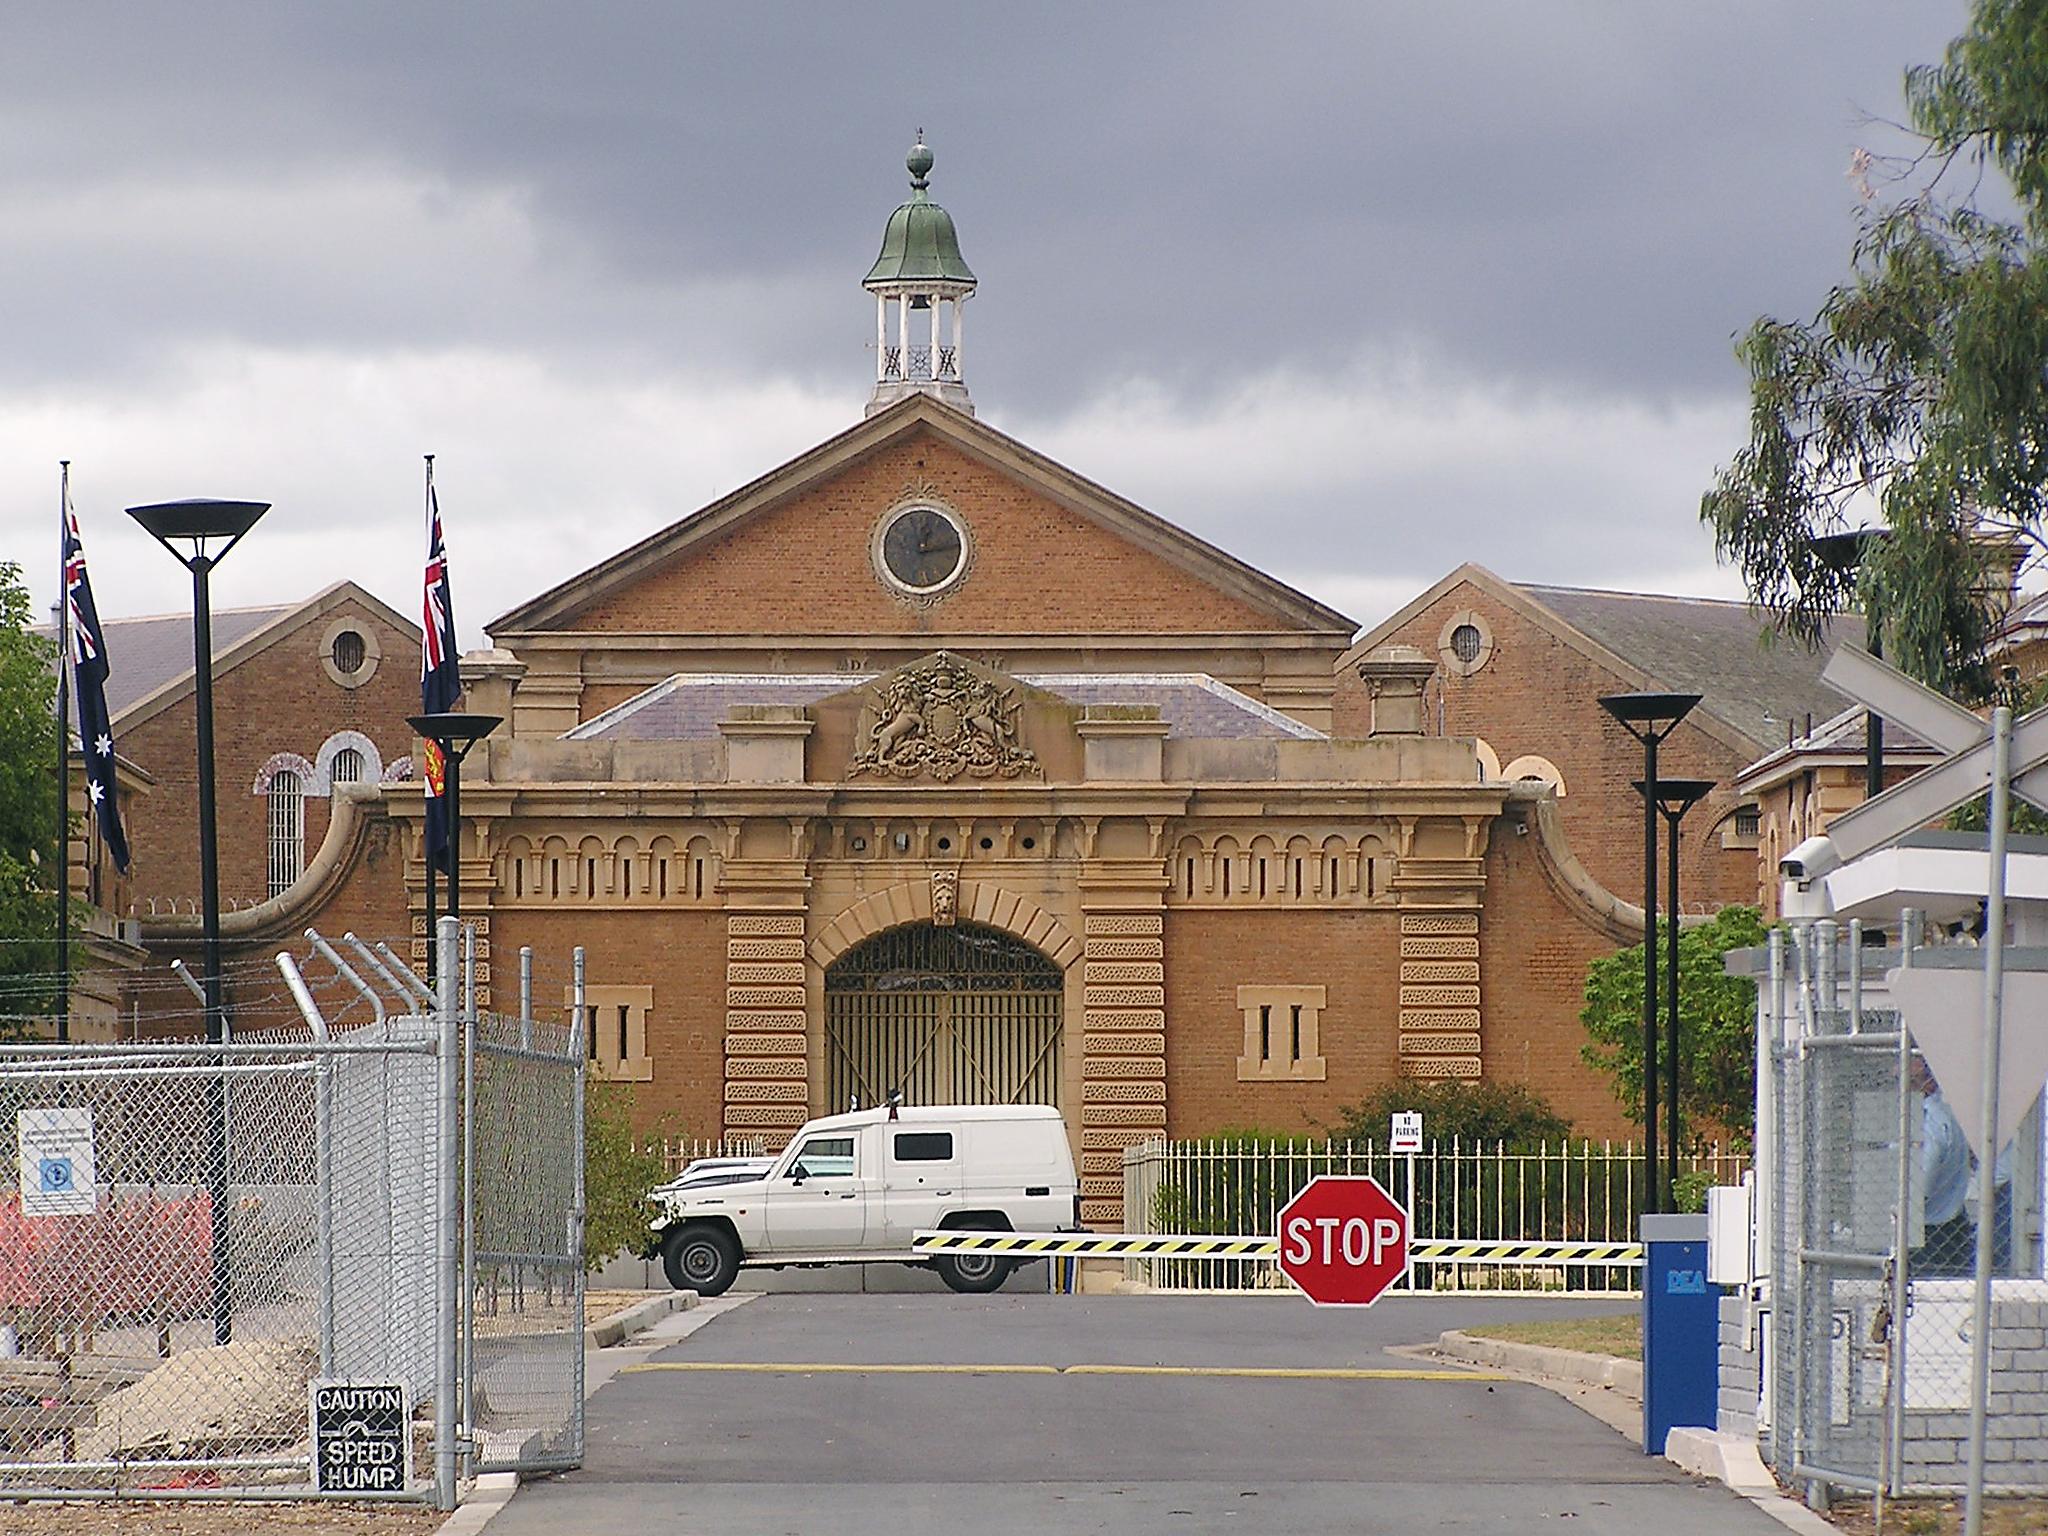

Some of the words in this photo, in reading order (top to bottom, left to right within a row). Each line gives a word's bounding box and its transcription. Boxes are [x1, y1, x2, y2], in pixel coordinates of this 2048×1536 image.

[1285, 1217, 1401, 1266] STOP
[318, 1390, 401, 1410] CAUTION
[327, 1441, 397, 1465] SPEED
[327, 1466, 396, 1489] HUMP
